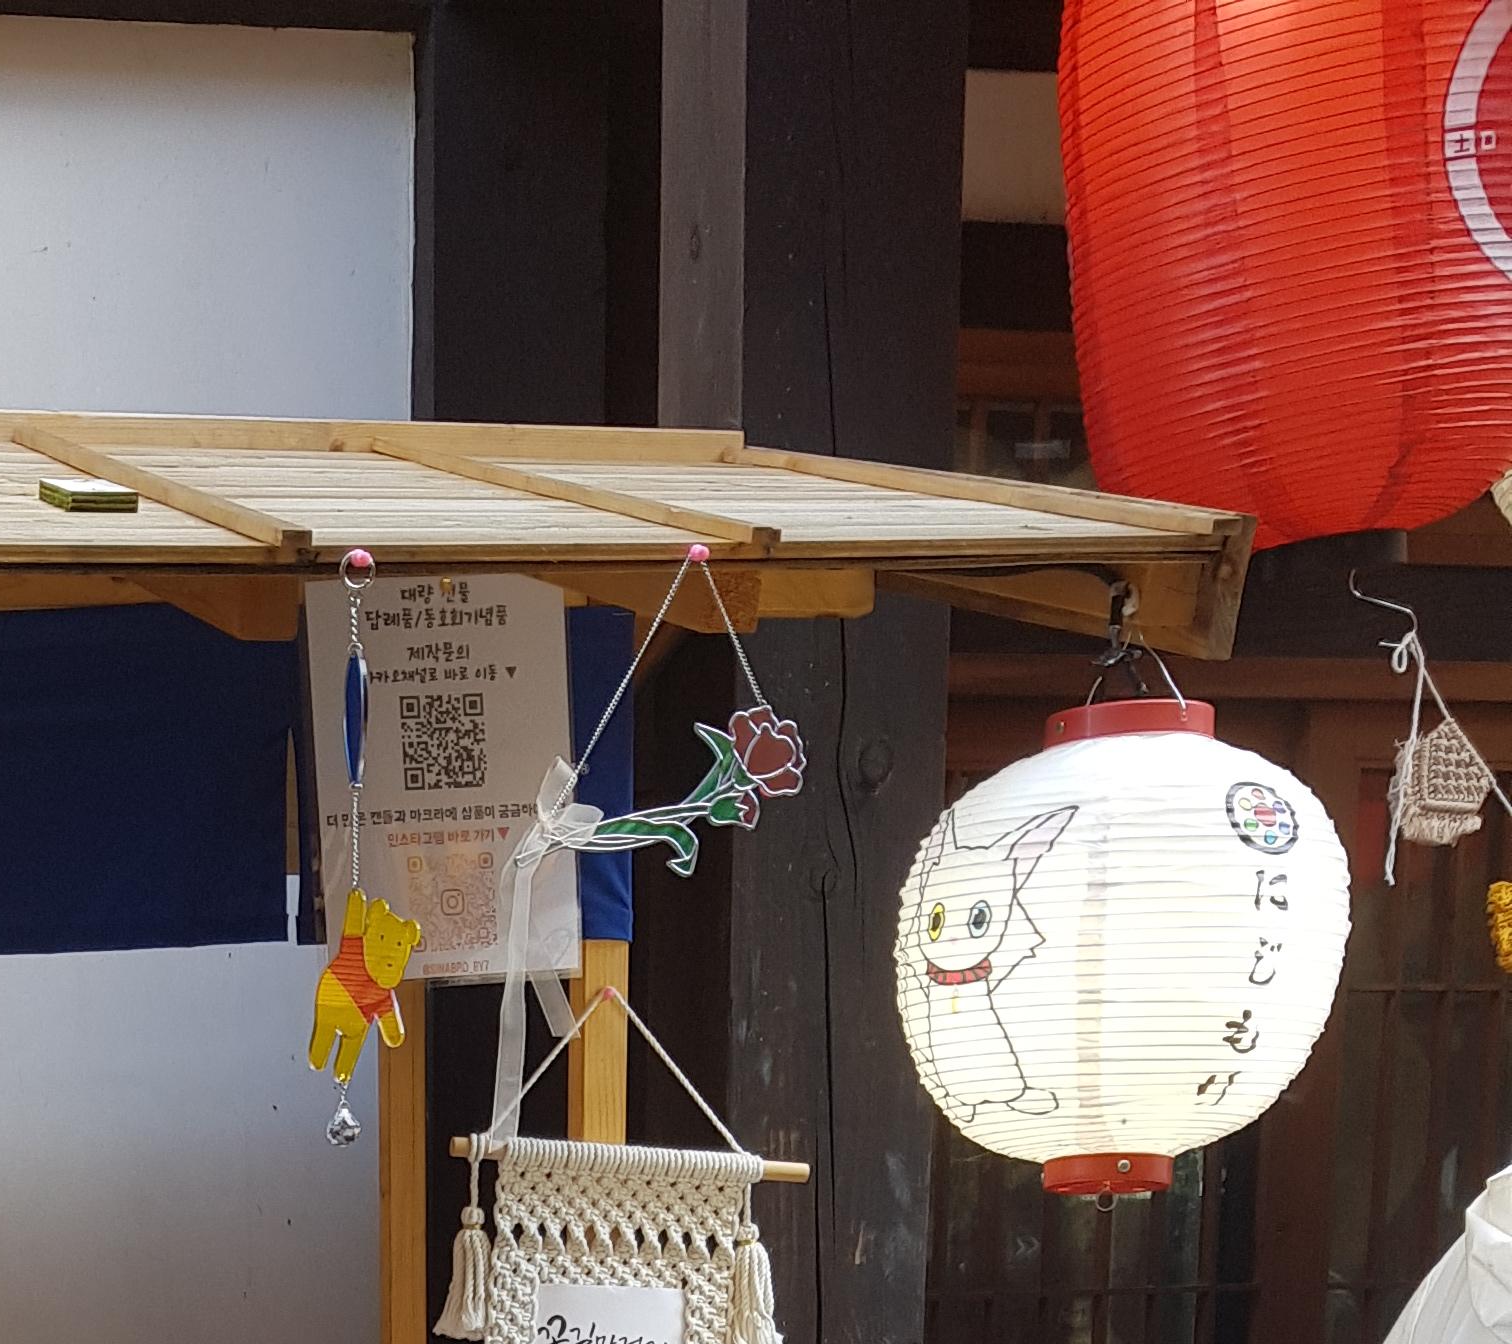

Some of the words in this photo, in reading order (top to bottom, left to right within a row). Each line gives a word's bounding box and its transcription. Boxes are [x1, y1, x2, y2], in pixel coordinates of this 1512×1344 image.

[400, 583, 435, 605] 대량
[407, 641, 470, 663] 제작문의
[444, 665, 470, 682] 바로
[474, 664, 498, 682] 이동
[326, 812, 338, 830] 더
[498, 801, 539, 819] 궁금하
[387, 831, 444, 849] 인스타그램
[448, 828, 472, 843] 바로
[474, 827, 495, 843] 가기
